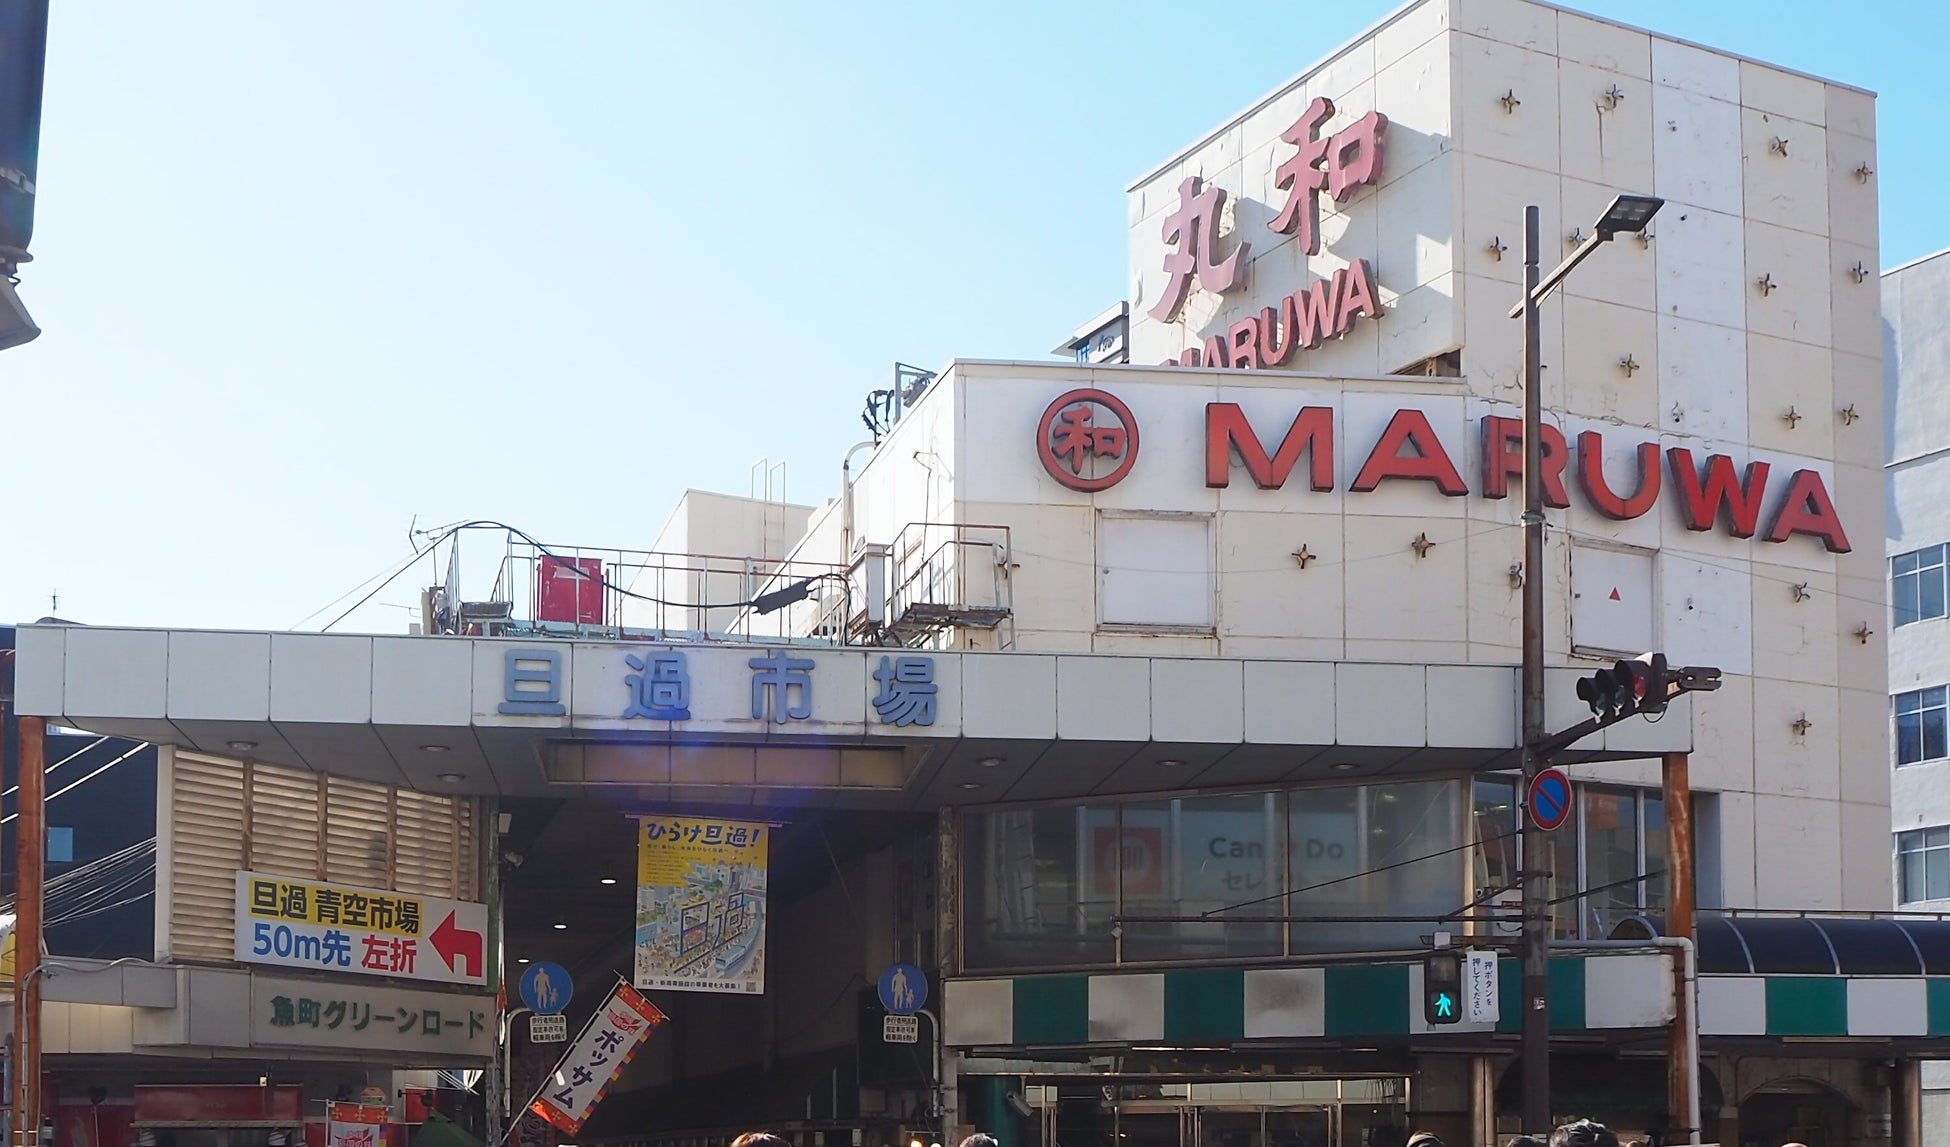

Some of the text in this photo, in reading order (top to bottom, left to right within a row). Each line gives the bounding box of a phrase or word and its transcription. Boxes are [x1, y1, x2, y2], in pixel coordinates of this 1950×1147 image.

[1161, 258, 1384, 369] ARUWA
[1054, 404, 1126, 473] 和
[1205, 402, 1852, 554] MARUWA
[498, 649, 938, 727] 旦過市場
[646, 821, 760, 848] ひらけ旦過!
[1209, 836, 1345, 860] Can Do
[251, 880, 419, 934] 旦過 青空市場
[253, 922, 418, 974] 50m先 左折
[1472, 957, 1482, 1016] 押してください
[1484, 960, 1494, 1006] 押ボタンを
[270, 995, 485, 1039] 魚町グリーンロード
[553, 1029, 624, 1110] ポッサム
